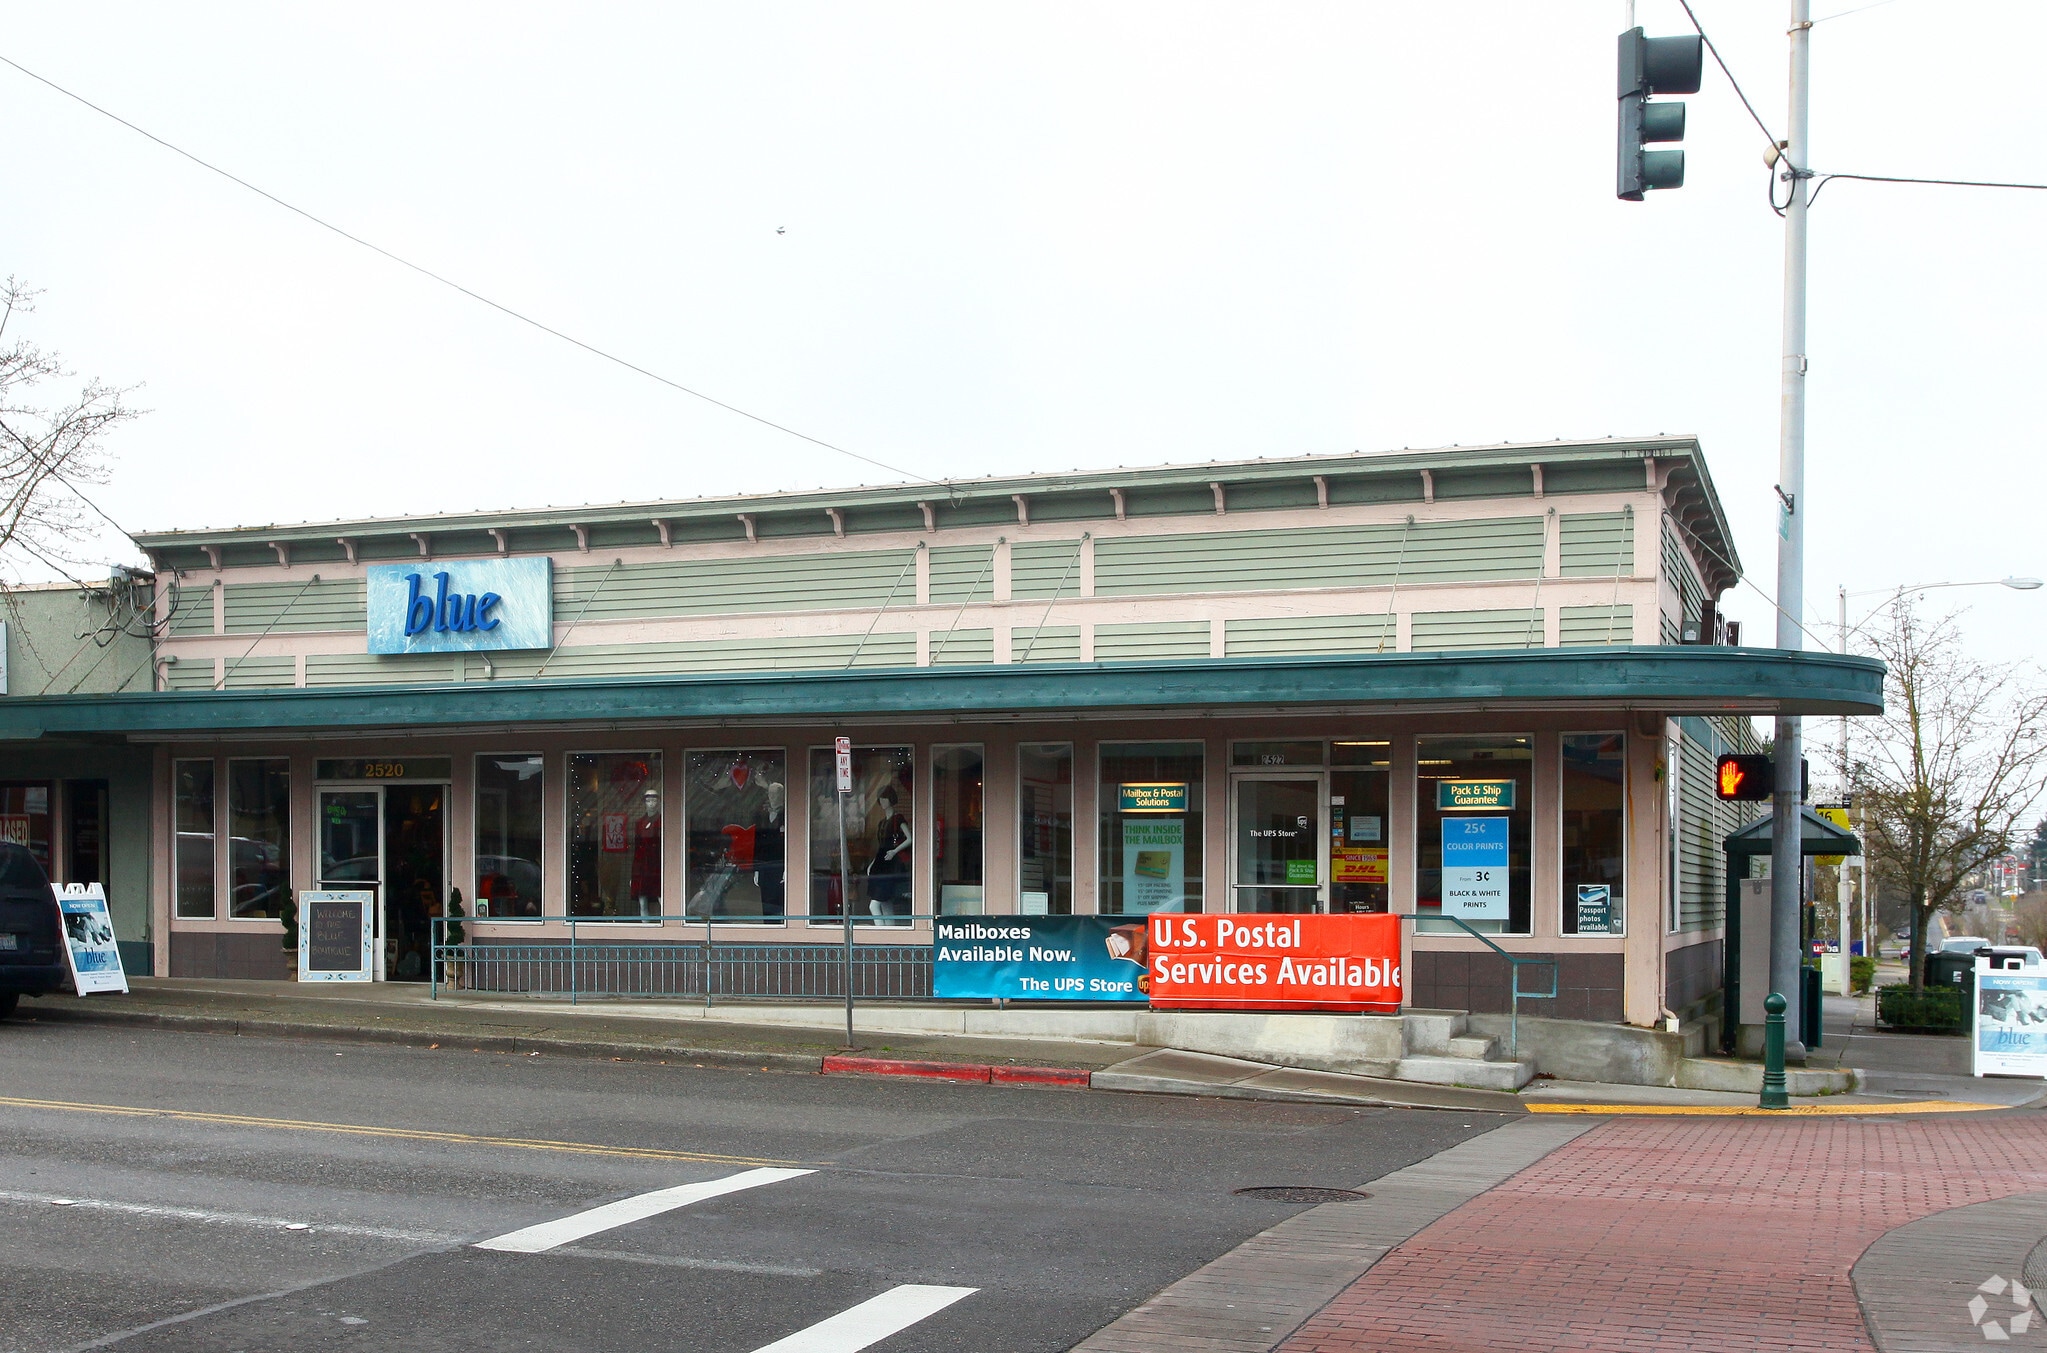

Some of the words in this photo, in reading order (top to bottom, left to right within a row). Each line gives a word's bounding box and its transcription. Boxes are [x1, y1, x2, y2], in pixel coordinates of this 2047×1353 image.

[404, 571, 502, 637] blue
[1262, 755, 1284, 765] 2522
[365, 763, 404, 777] 2520
[1123, 788, 1151, 798] Mailbox
[1153, 789, 1159, 797] &
[1161, 788, 1184, 797] Postal
[1451, 785, 1472, 795] Pack
[1473, 785, 1481, 795] &
[1483, 785, 1502, 798] Ship
[1136, 797, 1170, 807] Solutions
[1454, 795, 1498, 805] Guarantee
[0, 820, 28, 847] LOSED
[1125, 825, 1150, 834] THINK
[1153, 825, 1181, 834] INSIDE
[1464, 822, 1486, 834] 25¢
[1125, 835, 1141, 844] THE
[1143, 835, 1182, 844] MAILBOX
[1447, 842, 1473, 850] COLOR
[1476, 842, 1503, 850] PRINTS
[1344, 865, 1377, 873] DHL
[1475, 871, 1490, 882] 3¢
[1579, 906, 1607, 916] Passport
[1579, 914, 1601, 924] photos
[938, 923, 1031, 940] Mailboxes
[1154, 919, 1207, 948] U.S.
[1217, 918, 1300, 948] Postal
[1579, 923, 1608, 931] available
[84, 947, 107, 964] blue
[937, 946, 1023, 962] Available
[1029, 946, 1076, 962] Now.
[1154, 955, 1267, 985] Services
[1276, 956, 1400, 988] Available
[1020, 976, 1048, 991] The
[1054, 977, 1084, 992] UPS
[1089, 978, 1133, 993] Store
[1139, 980, 1149, 993] up
[1998, 1026, 2031, 1045] blue
